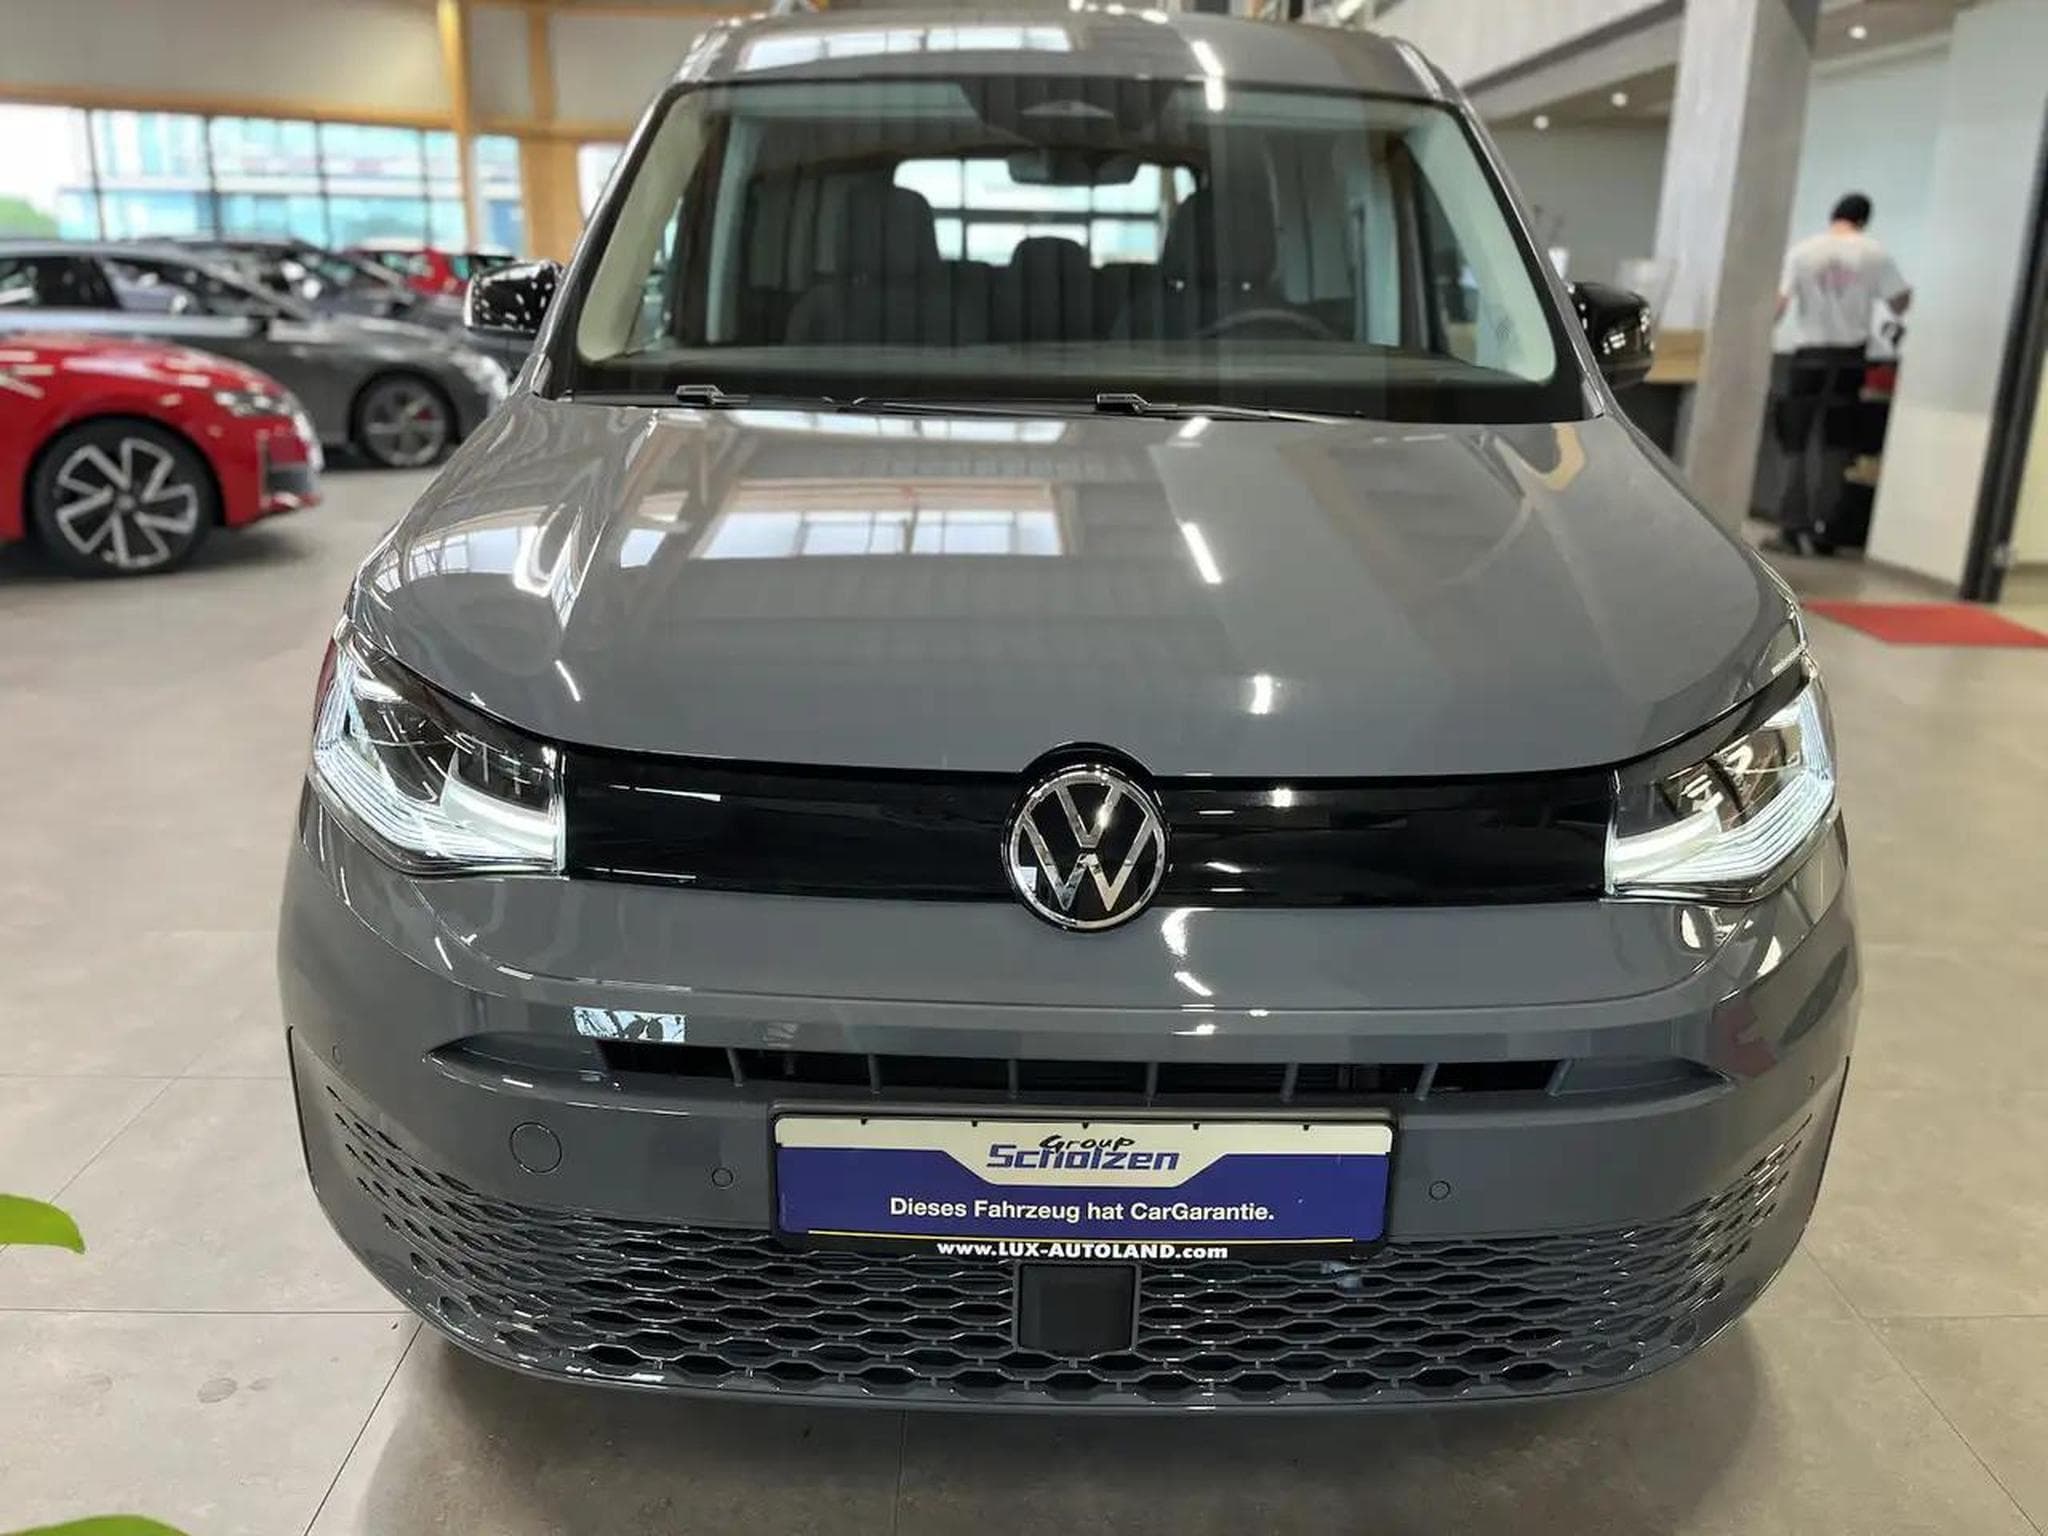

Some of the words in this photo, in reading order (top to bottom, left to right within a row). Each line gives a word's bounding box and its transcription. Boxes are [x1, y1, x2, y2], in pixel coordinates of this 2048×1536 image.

[1039, 1134, 1136, 1154] Group
[986, 1143, 1181, 1170] Scholzen
[889, 1197, 967, 1217] Dieses
[974, 1199, 1080, 1223] Fahrzeug
[1087, 1202, 1124, 1220] hat
[1130, 1202, 1275, 1220] CarGarantie.
[936, 1242, 1228, 1259] www.LUX-AUTOLAND.com
